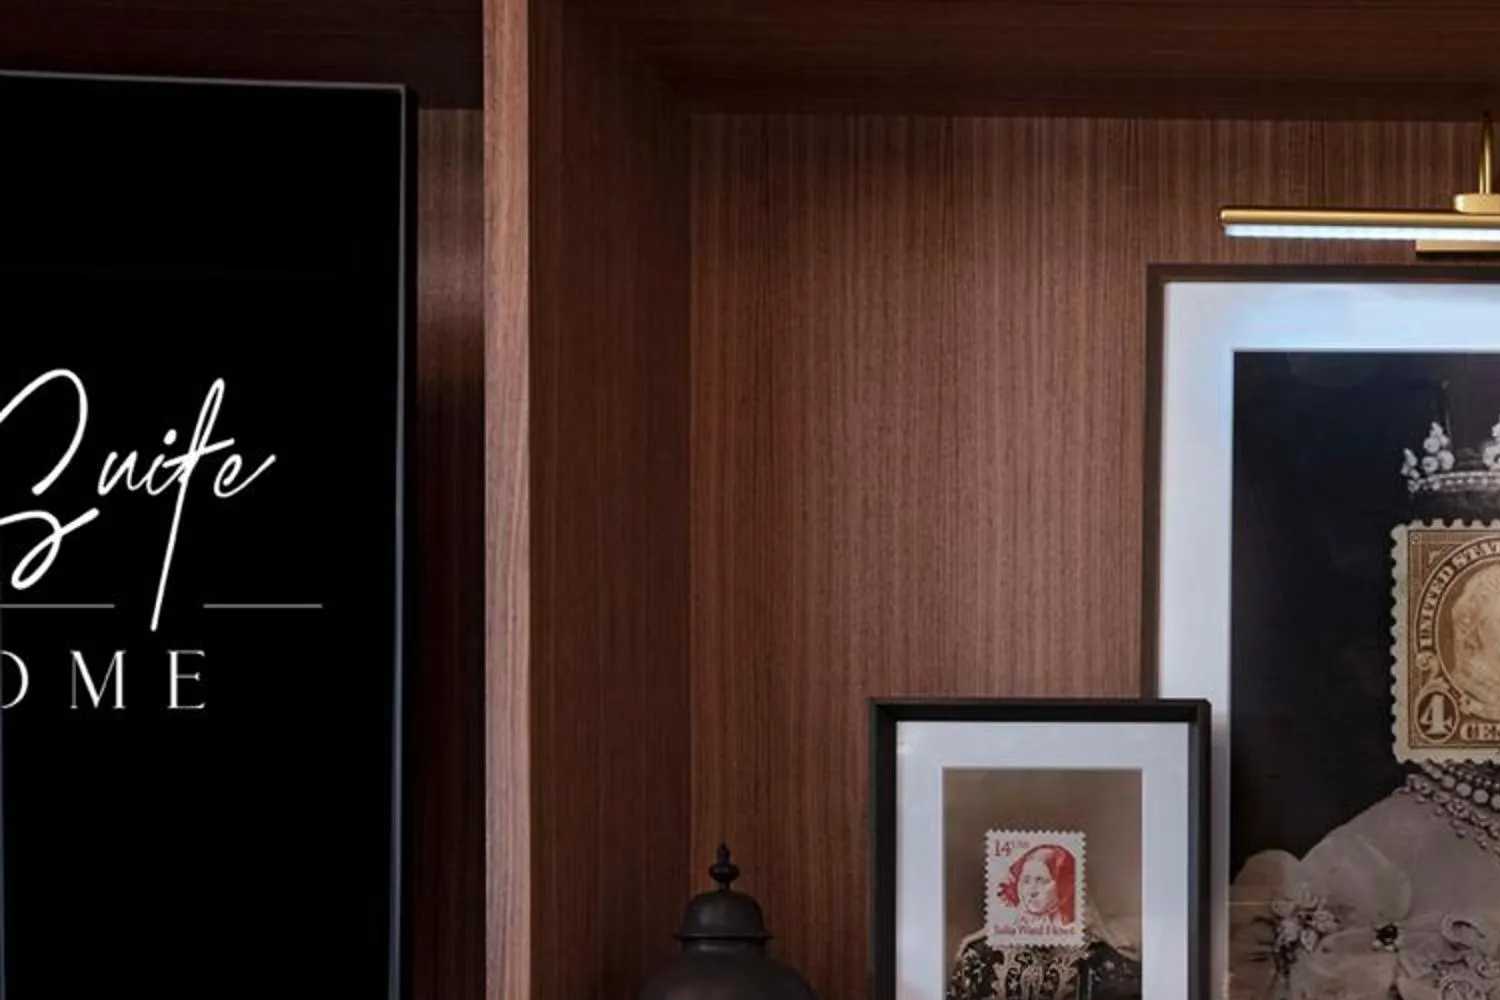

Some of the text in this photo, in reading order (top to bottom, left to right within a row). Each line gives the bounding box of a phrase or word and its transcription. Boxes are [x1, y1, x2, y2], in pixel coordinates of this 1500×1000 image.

[1419, 565, 1455, 649] UNITED
[1419, 694, 1453, 736] 4
[994, 839, 1012, 857] 14
